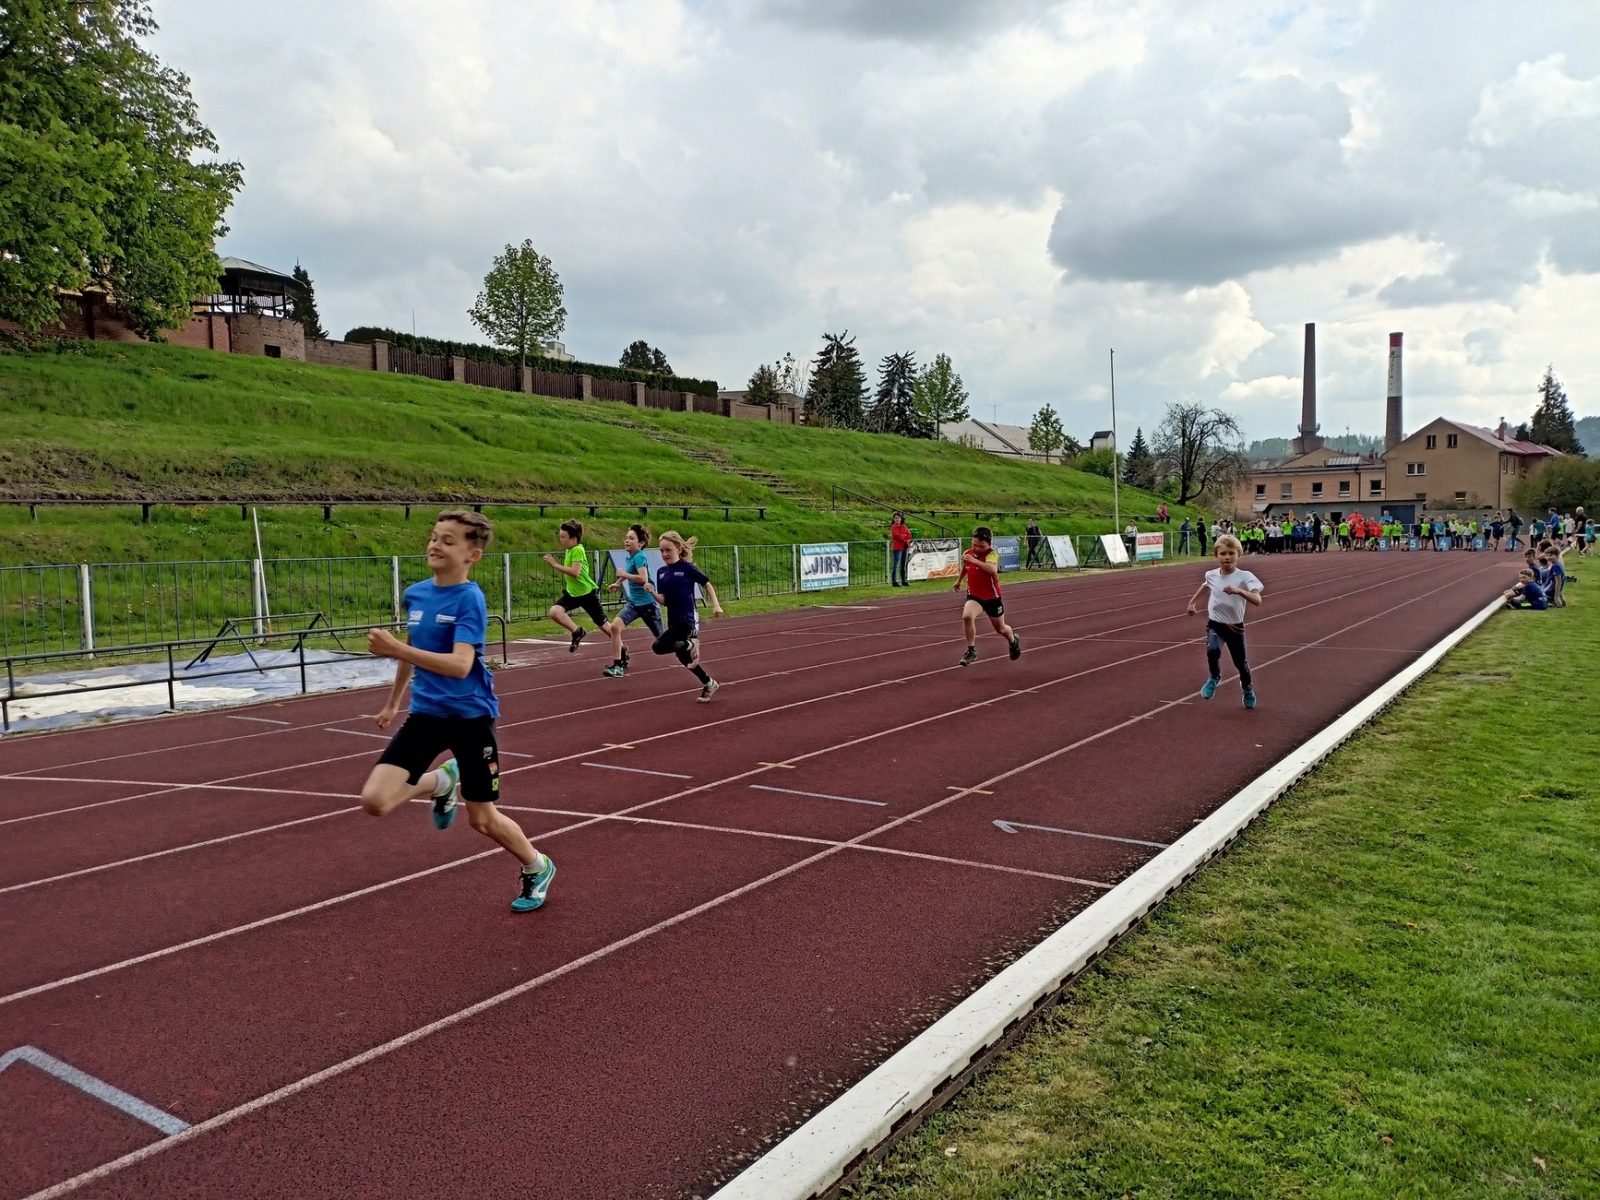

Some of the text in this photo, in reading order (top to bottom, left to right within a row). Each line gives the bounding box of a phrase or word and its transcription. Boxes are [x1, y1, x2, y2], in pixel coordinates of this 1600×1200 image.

[1379, 540, 1386, 548] 6
[1409, 539, 1417, 548] 5
[1440, 539, 1447, 548] 4
[1476, 539, 1483, 548] 3
[811, 555, 842, 575] JIRY
